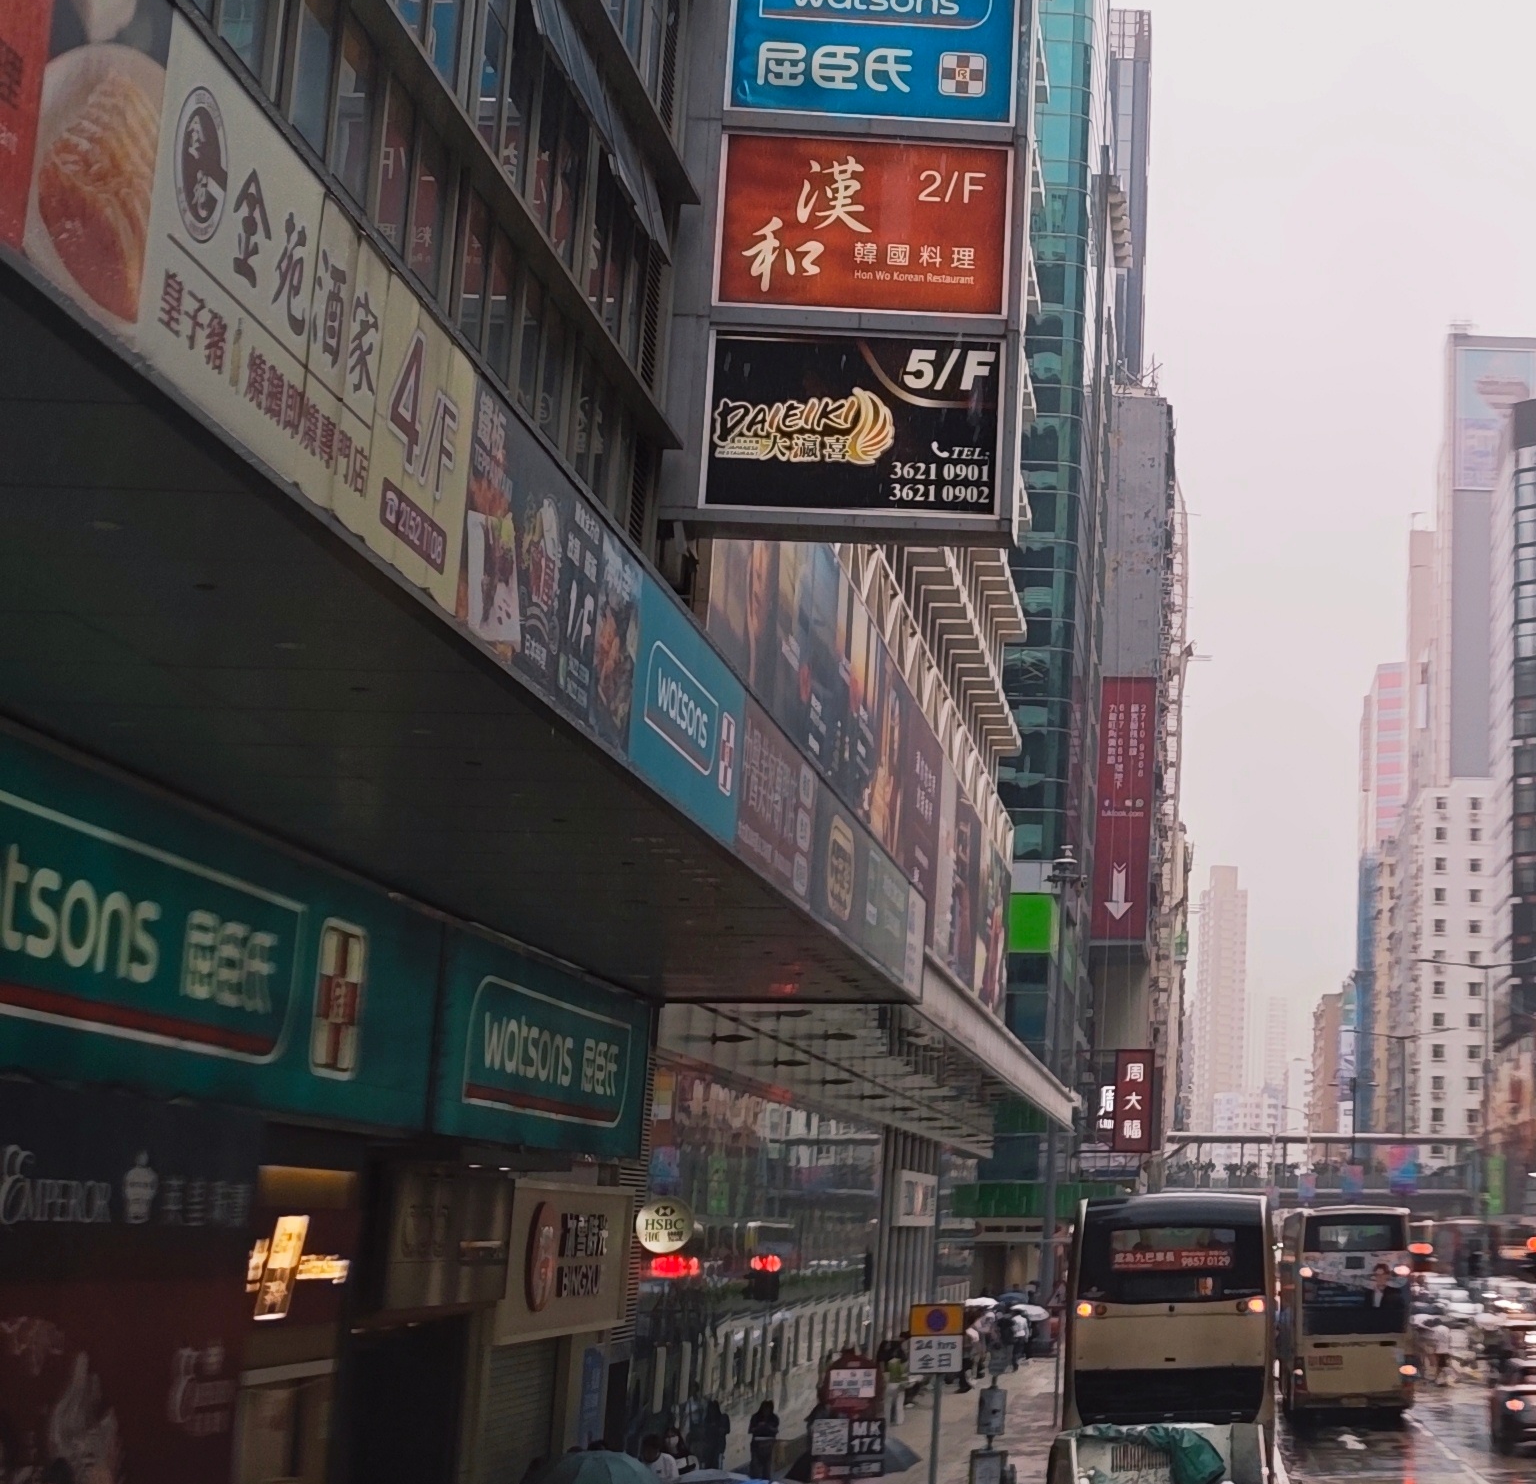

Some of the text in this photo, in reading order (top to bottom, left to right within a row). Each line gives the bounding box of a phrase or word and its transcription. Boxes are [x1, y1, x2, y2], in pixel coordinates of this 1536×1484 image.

[757, 41, 913, 93] 屈臣氏
[918, 170, 986, 204] 2/F
[853, 242, 976, 269] 韓國料理
[233, 168, 379, 397] 金苑酒家
[854, 270, 975, 286] Hon Wo Korean Restaurant
[903, 348, 997, 390] 5/F
[386, 329, 457, 500] 4/F
[951, 446, 991, 460] TEL:
[889, 462, 990, 482] 3621 0901
[889, 483, 990, 504] 3621 0902
[658, 667, 709, 750] watsons
[484, 1010, 575, 1090] watsons
[1123, 1062, 1145, 1140] 周大福
[644, 1218, 685, 1231] HSBC
[915, 1340, 933, 1351] 24
[918, 1353, 952, 1369] 全日
[852, 1420, 881, 1436] MK
[851, 1437, 881, 1453] 174
